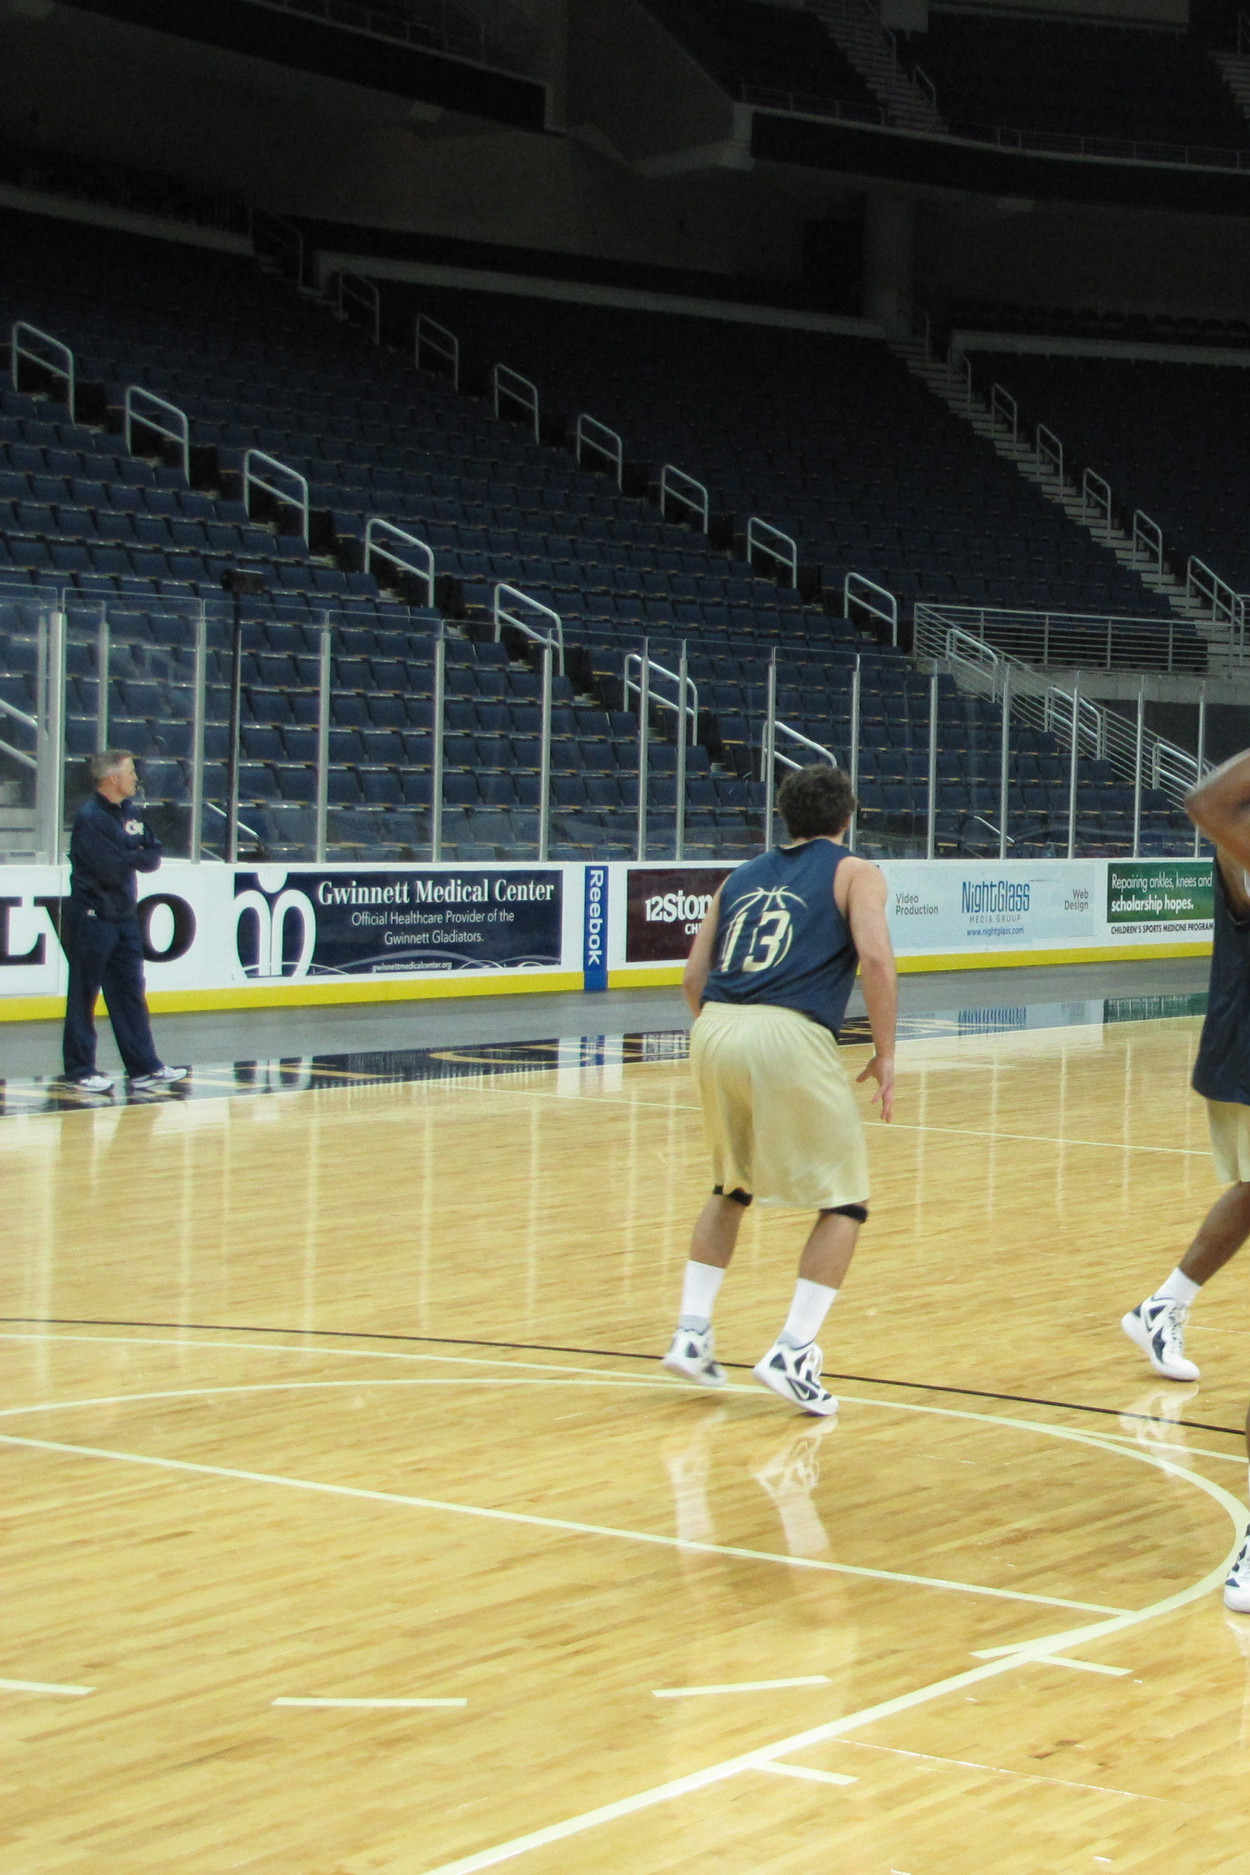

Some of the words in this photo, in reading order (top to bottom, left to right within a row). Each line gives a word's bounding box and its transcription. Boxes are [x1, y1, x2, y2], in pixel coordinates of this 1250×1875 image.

[1111, 873, 1147, 893] Repairing
[1149, 872, 1174, 889] ankles,
[1176, 872, 1197, 887] knees
[1198, 871, 1213, 886] and
[318, 881, 410, 905] Gwinnett
[416, 879, 489, 903] Medical
[494, 879, 555, 902] Center
[896, 893, 919, 904] Video
[961, 880, 1031, 914] NightGlass
[1072, 889, 1089, 900] Web
[895, 904, 939, 916] Production
[1064, 900, 1089, 912] Design
[1111, 895, 1163, 914] scholarship
[1164, 894, 1194, 913] hopes.
[351, 912, 387, 926] Official
[390, 910, 443, 925] Healthcare
[445, 909, 485, 923] Provider
[487, 908, 498, 922] of
[499, 908, 515, 921] the
[588, 870, 604, 966] Reebok
[969, 916, 993, 924] MEDIA
[996, 914, 1021, 923] GROUP
[966, 927, 1025, 937] www.nightglass.com
[1142, 925, 1162, 933] SPORTS
[1162, 923, 1187, 932] MEDICINE
[384, 931, 430, 945] Gwinnett
[432, 929, 485, 943] Gladiators.
[721, 910, 791, 972] 13
[372, 961, 453, 974] gwinnettmedicalcenter.org
